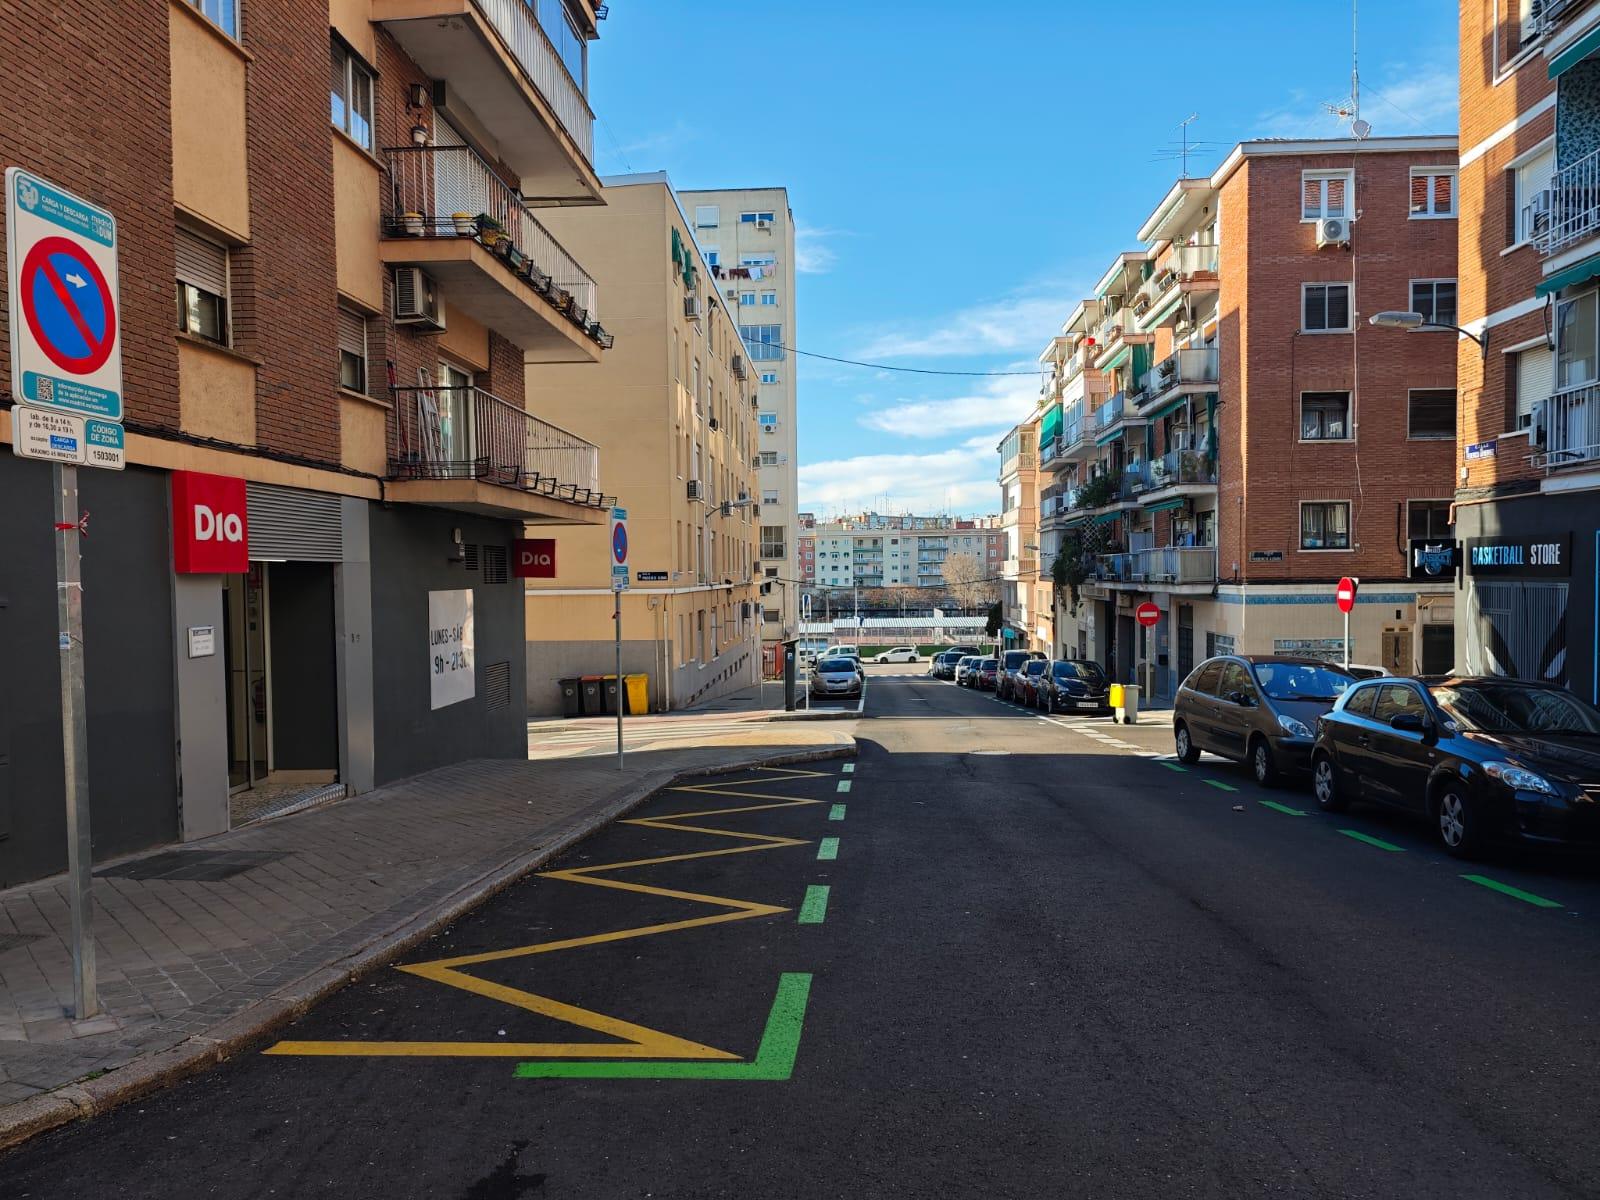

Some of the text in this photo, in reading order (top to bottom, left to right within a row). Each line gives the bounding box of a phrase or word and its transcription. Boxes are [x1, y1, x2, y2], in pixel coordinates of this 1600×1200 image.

[42, 196, 58, 209] CARGA
[64, 206, 89, 222] DESCARGA
[92, 424, 117, 436] CÓDIGO
[100, 435, 119, 444] ZONA
[93, 450, 119, 462] 1503001
[1472, 543, 1561, 566] BASKETBALL STORE
